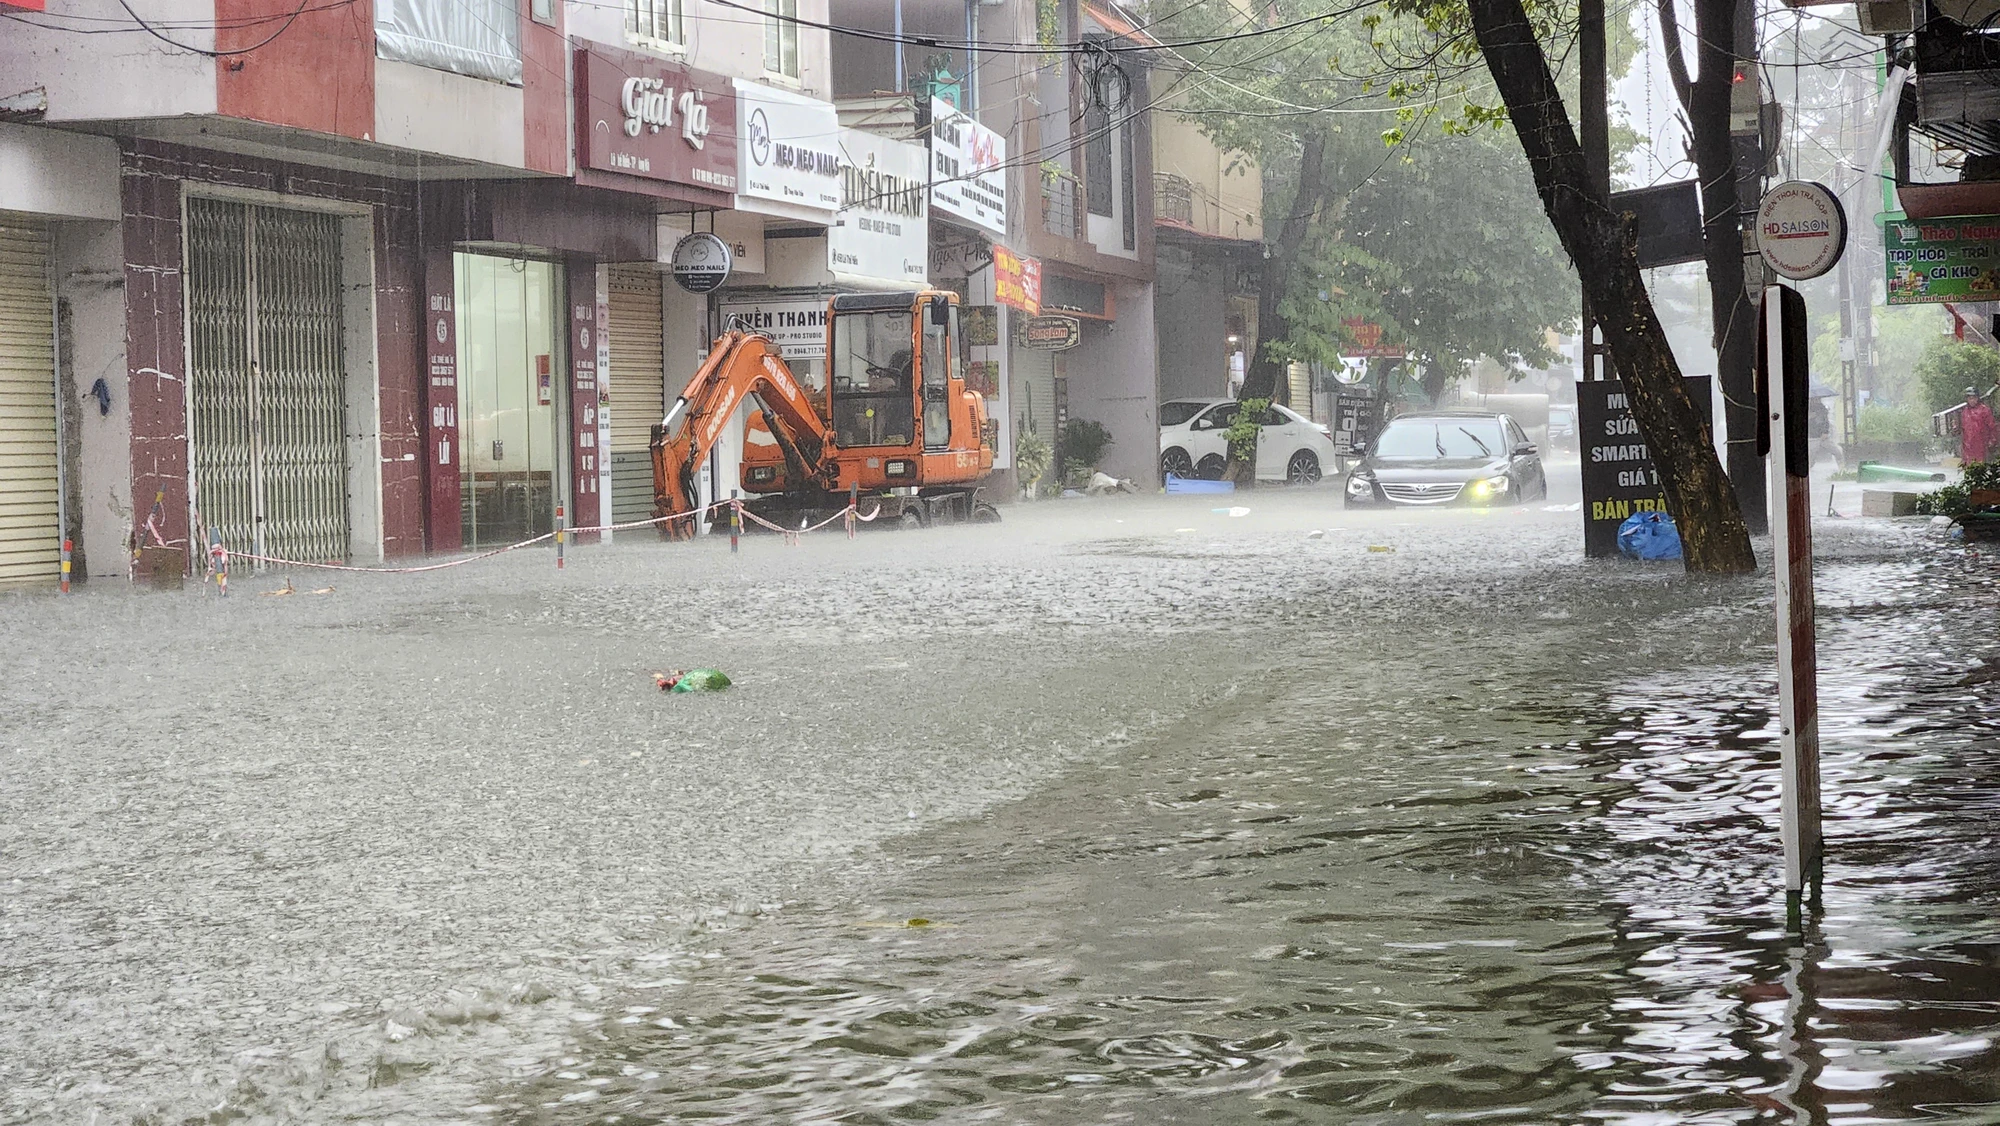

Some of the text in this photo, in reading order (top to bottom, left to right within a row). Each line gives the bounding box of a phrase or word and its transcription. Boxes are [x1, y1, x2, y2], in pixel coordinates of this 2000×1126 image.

[621, 77, 710, 150] Giặt Là
[816, 152, 839, 177] NAILS
[884, 174, 925, 218] THANH
[1763, 219, 1829, 234] HD SAISON
[1930, 264, 1980, 279] CÁ KHO
[778, 310, 827, 328] THANH
[790, 332, 801, 340] PRO
[802, 331, 822, 340] STUDIO
[1605, 414, 1639, 436] SỬA
[1591, 444, 1651, 463] SMART
[1618, 467, 1647, 487] GIÁ
[1592, 491, 1668, 521] BÁN TRẢ
